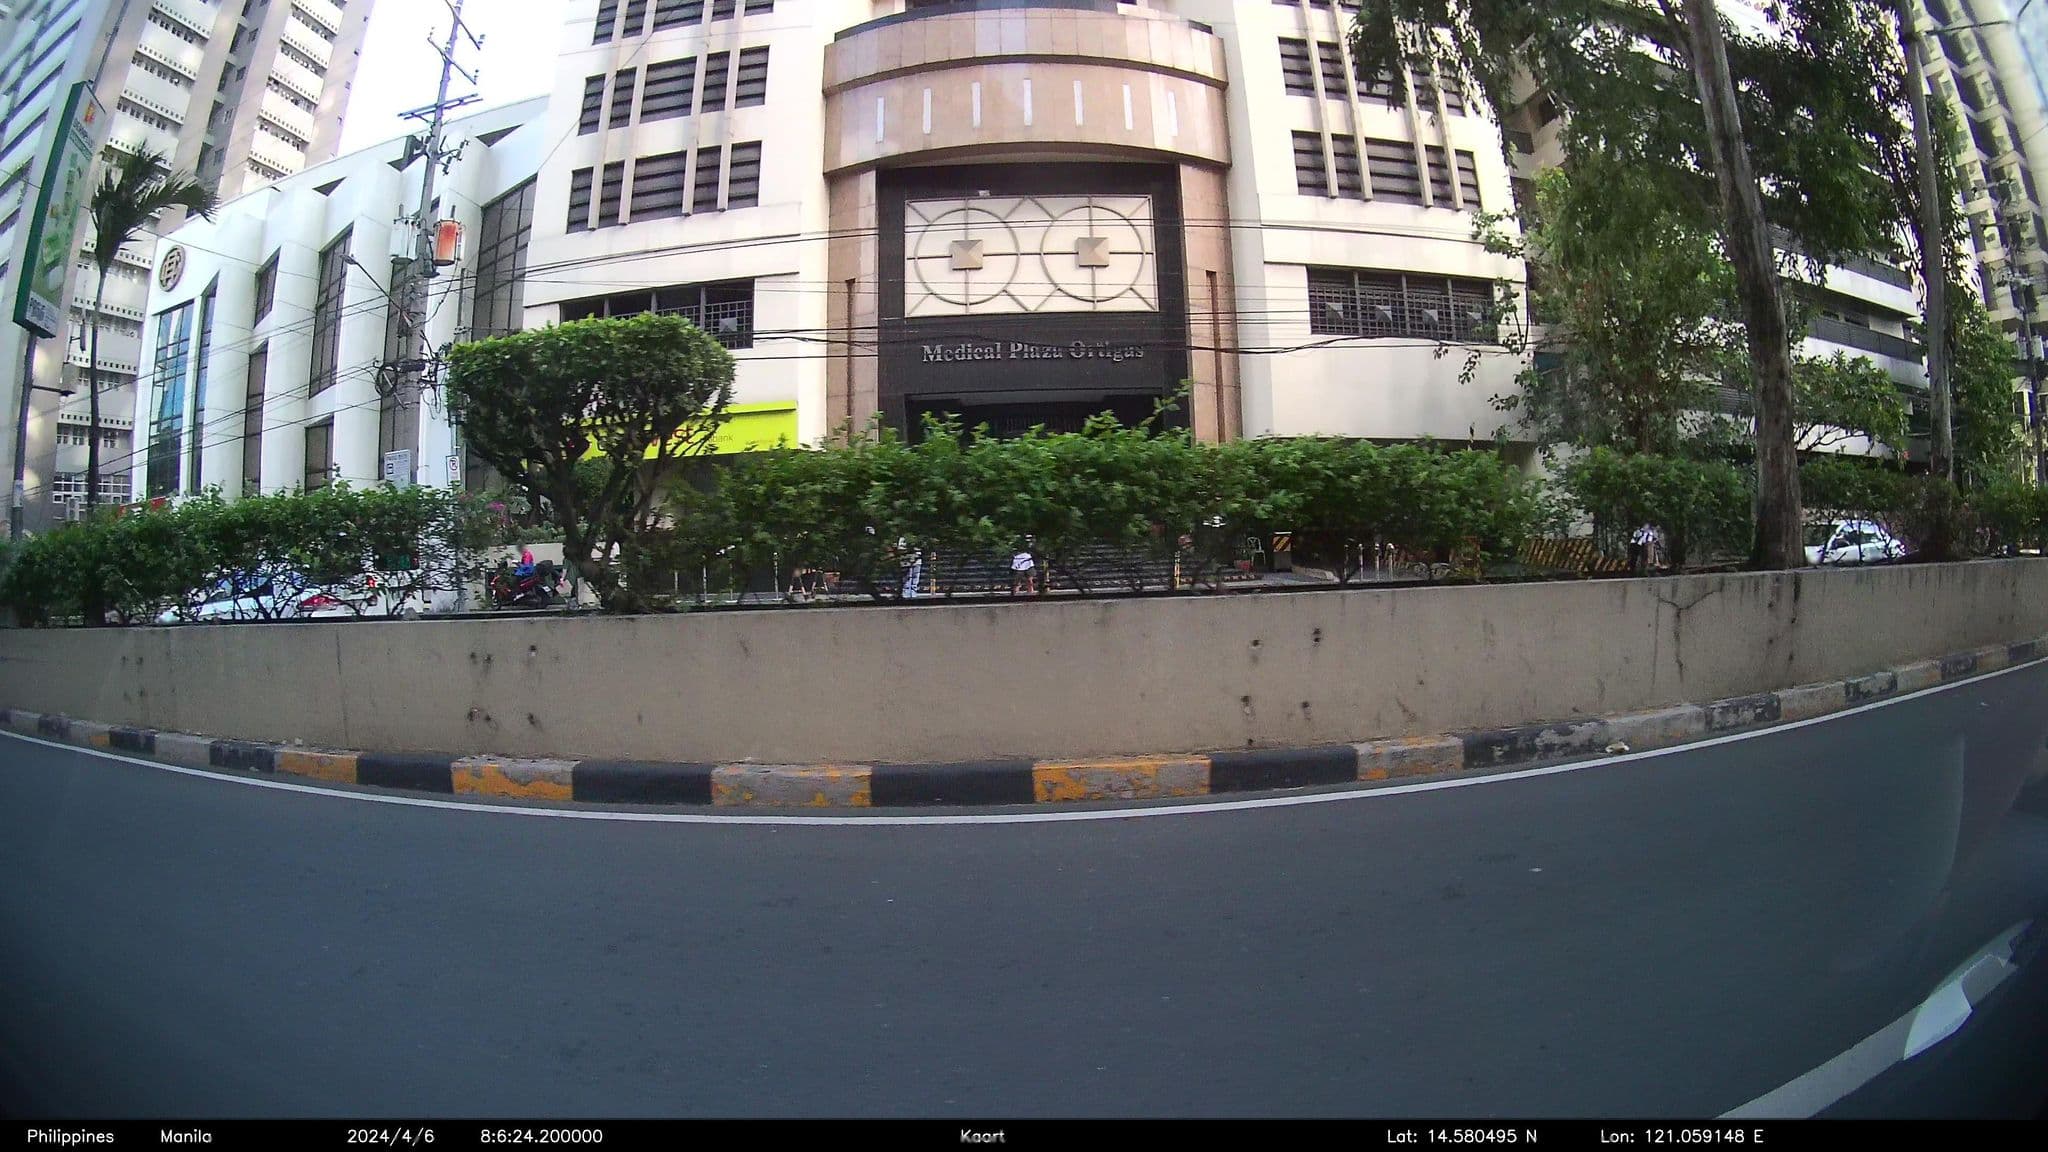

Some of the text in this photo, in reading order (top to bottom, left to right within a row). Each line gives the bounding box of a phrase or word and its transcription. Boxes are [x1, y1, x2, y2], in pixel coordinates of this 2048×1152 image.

[921, 340, 1146, 362] Medical Plaza Ortigas
